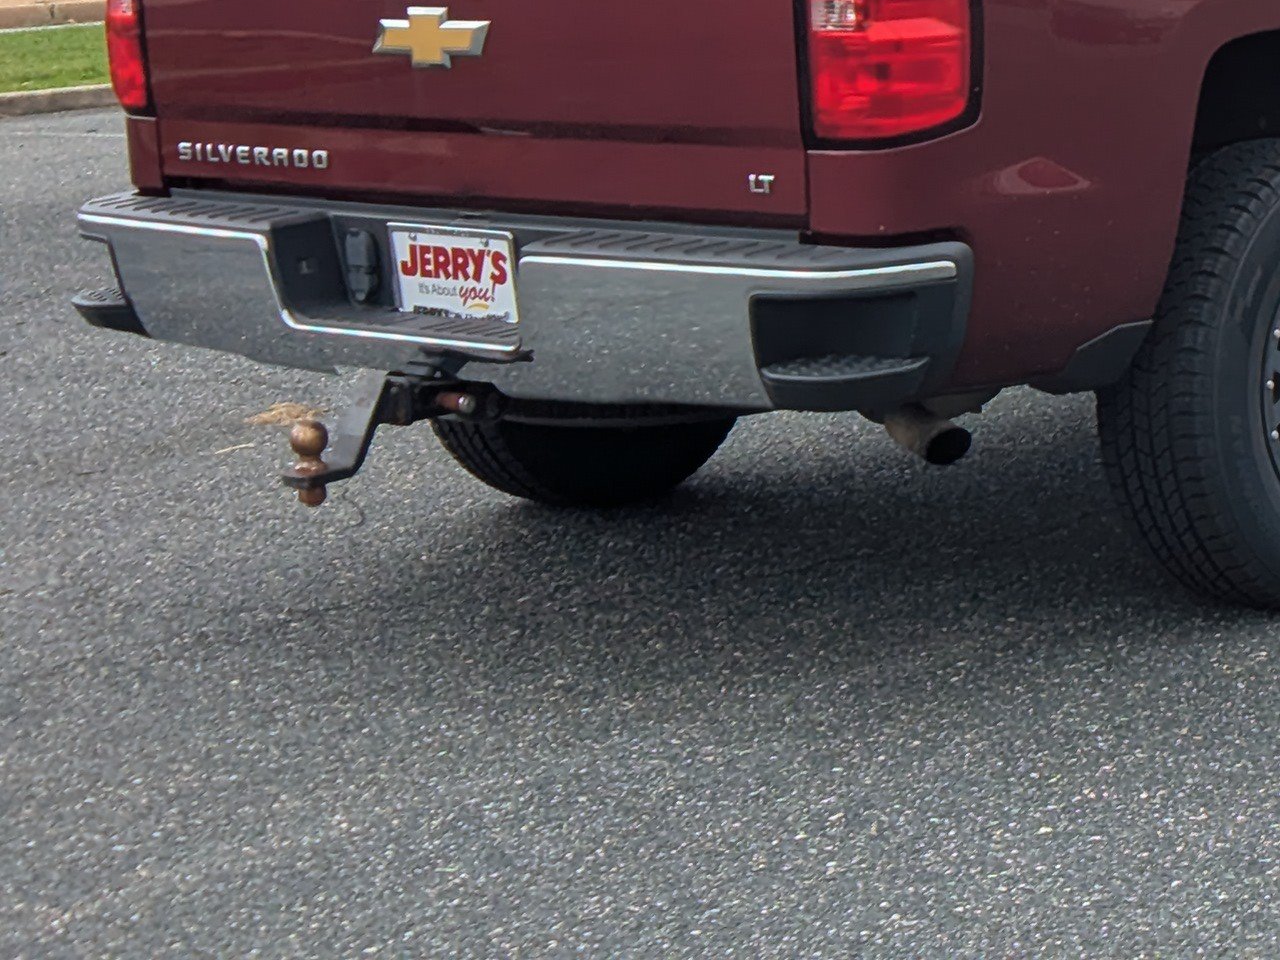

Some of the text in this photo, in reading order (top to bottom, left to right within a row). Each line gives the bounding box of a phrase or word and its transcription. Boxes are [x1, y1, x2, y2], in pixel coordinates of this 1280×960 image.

[177, 141, 329, 169] SILVERADO
[748, 173, 775, 194] LT
[400, 243, 508, 286] JERRY'S
[431, 283, 458, 297] About
